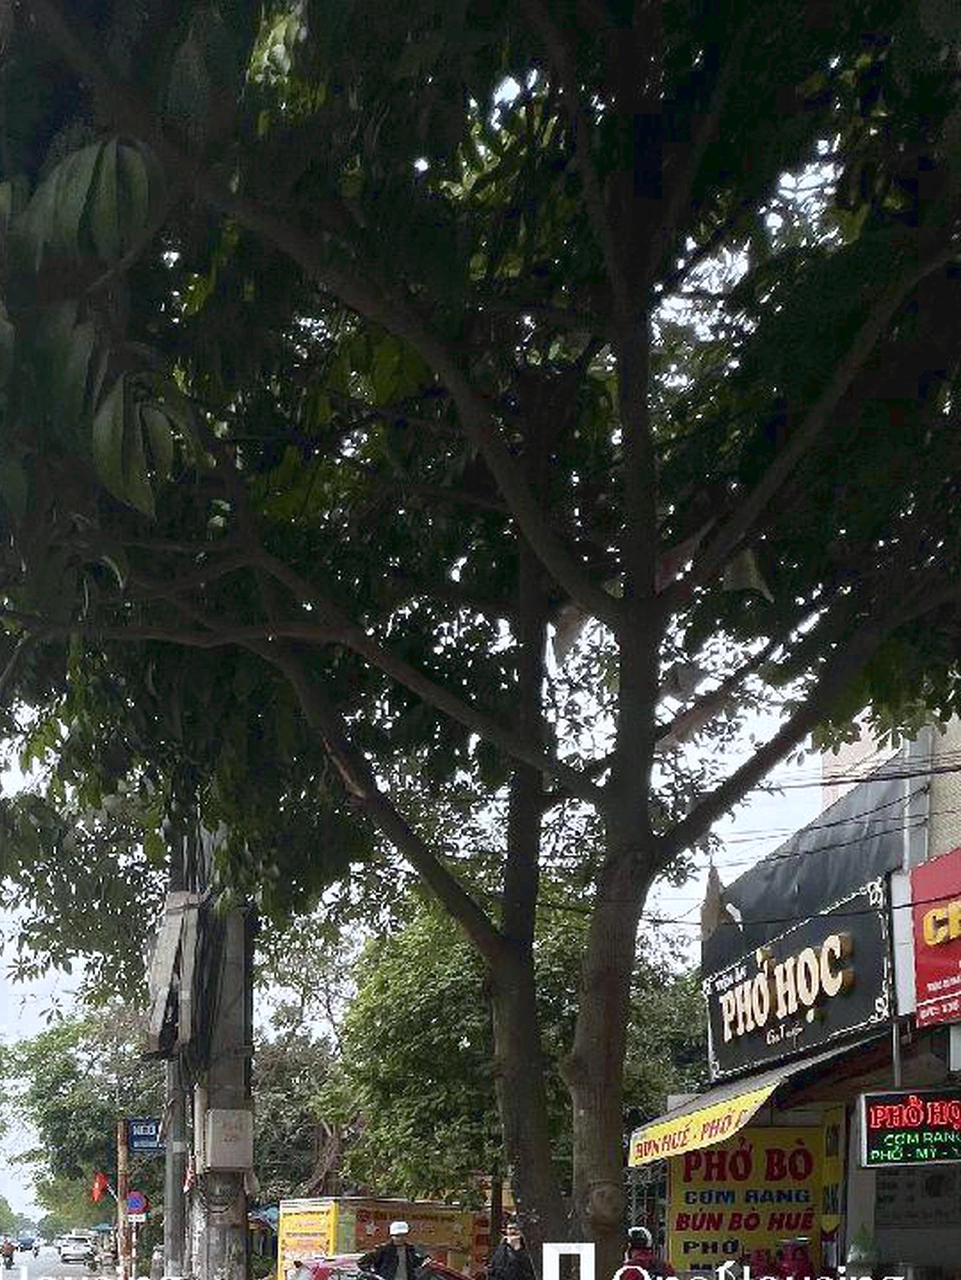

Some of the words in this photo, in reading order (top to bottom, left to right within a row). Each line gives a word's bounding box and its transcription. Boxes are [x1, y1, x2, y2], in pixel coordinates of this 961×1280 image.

[719, 948, 771, 1043] PHỞ
[774, 934, 848, 1023] HỌC
[869, 1095, 924, 1128] PHỞ
[682, 1136, 754, 1183] PHỞ
[764, 1138, 814, 1182] BÒ
[684, 1189, 735, 1205] CƠM
[744, 1189, 811, 1204] RANG
[675, 1208, 723, 1232] BÚN
[727, 1208, 761, 1232] BÒ
